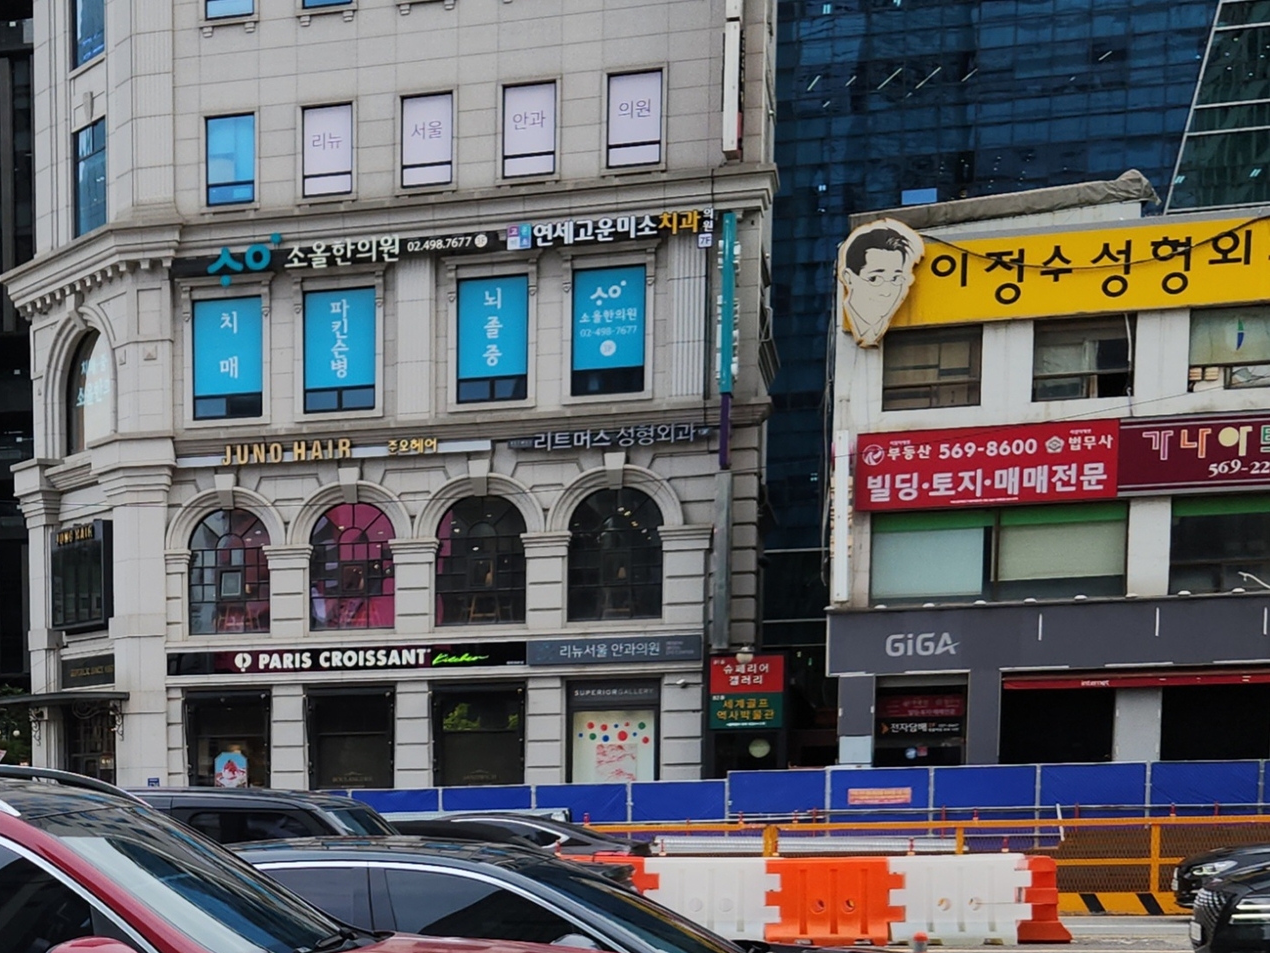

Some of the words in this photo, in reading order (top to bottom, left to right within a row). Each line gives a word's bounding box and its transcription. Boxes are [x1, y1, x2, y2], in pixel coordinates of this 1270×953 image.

[311, 132, 342, 150] 리뉴
[411, 120, 443, 139] 서울
[512, 110, 547, 130] 안과
[618, 99, 652, 119] 의원
[284, 235, 400, 269] 소올한의원
[407, 236, 472, 253] 02.498.7677
[930, 229, 1270, 305] 이정수성형외
[331, 299, 349, 378] 파킨슨병
[483, 287, 503, 366] 뇌졸중
[220, 311, 239, 379] 치매
[534, 429, 610, 451] 리트머스
[616, 423, 695, 447] 성형외과
[887, 444, 932, 461] 부동산
[938, 439, 1038, 459] 569-8600
[1068, 434, 1114, 451] 법무사
[222, 442, 283, 466] JUNO
[293, 438, 351, 461] HAIR
[388, 438, 438, 455] 준오헤어
[559, 643, 607, 659] 리뉴서울
[611, 641, 660, 657] 안과의원
[885, 631, 960, 657] GiGA
[259, 652, 312, 669] PARIS
[319, 649, 426, 668] CROISSANT
[723, 663, 769, 674] 슈페리어
[729, 675, 763, 686] 갤러리
[891, 723, 928, 733] 전자담배
